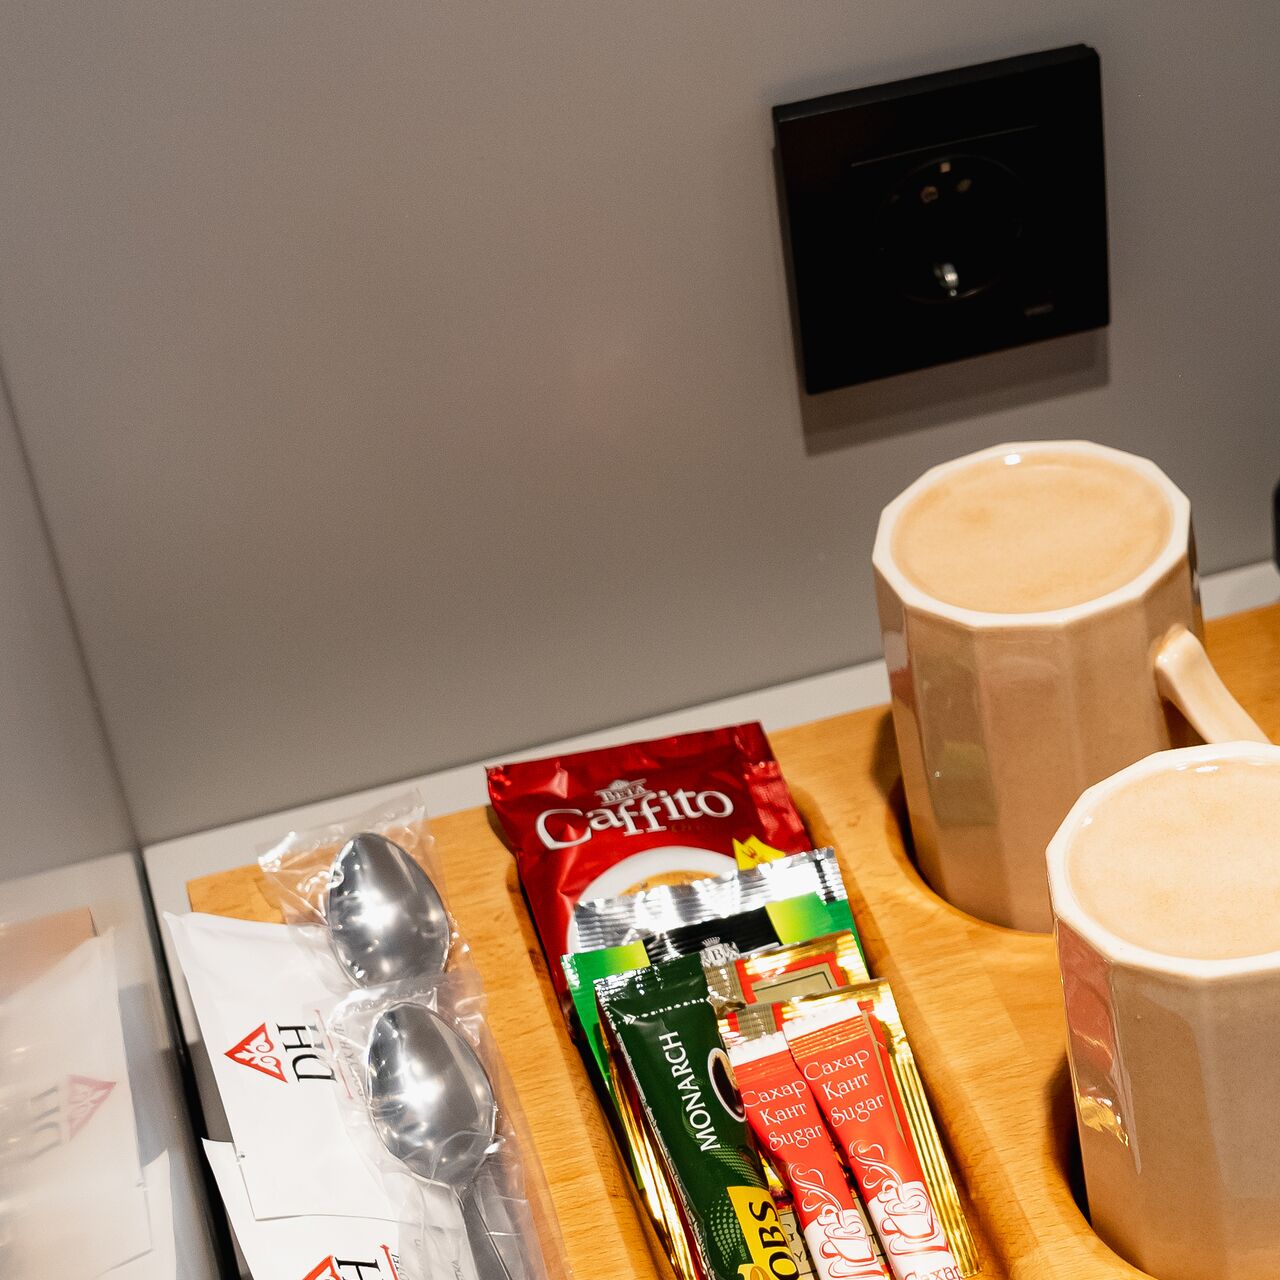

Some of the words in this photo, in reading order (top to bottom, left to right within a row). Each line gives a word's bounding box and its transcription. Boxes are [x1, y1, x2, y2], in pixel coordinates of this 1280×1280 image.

[535, 788, 734, 851] Caffito
[276, 1022, 338, 1083] DH
[804, 1050, 870, 1081] Сахар
[658, 1031, 722, 1152] MONARCH
[741, 1080, 807, 1108] Сахар
[822, 1073, 869, 1100] Қант
[760, 1103, 807, 1126] Қант
[830, 1094, 885, 1127] Sugar
[768, 1125, 822, 1152] Sugar
